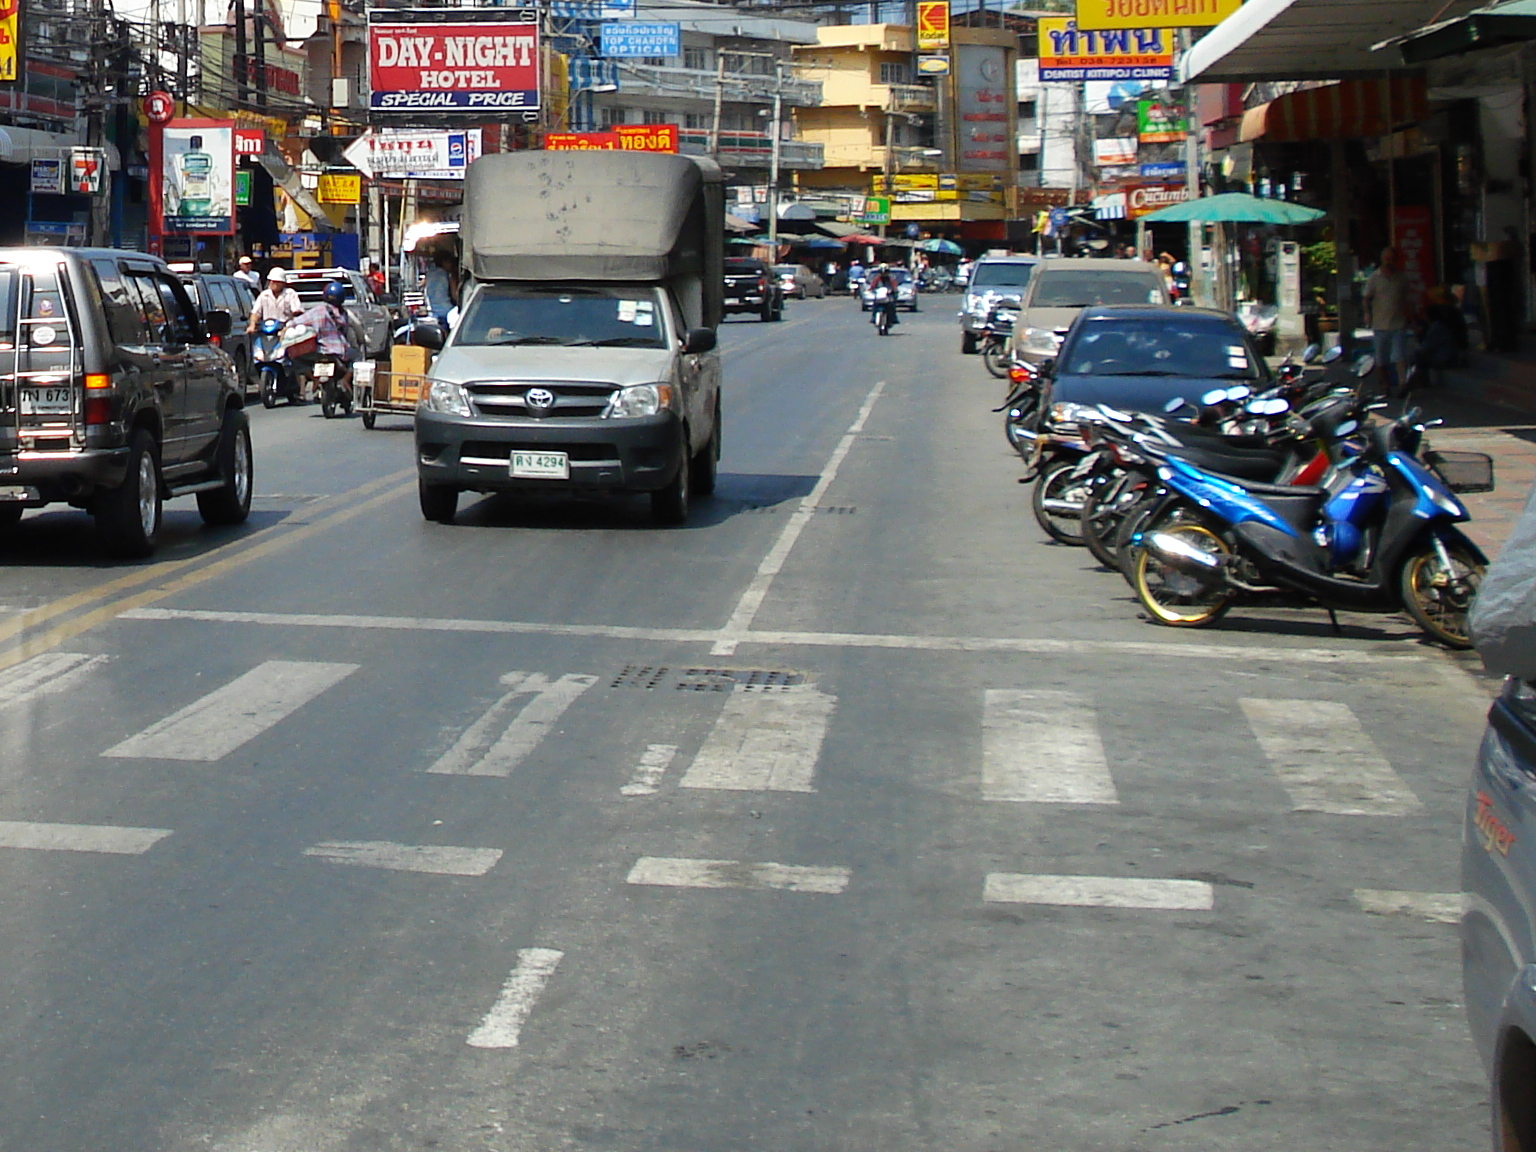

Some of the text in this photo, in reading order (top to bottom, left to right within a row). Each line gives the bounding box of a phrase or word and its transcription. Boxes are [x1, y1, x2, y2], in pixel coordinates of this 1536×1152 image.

[1049, 20, 1164, 55] ทำฟน
[377, 35, 535, 68] DAY-NIGHT
[420, 70, 501, 88] HOTEL
[1043, 68, 1086, 80] DENTIST
[1132, 66, 1170, 78] CLINIC
[380, 92, 525, 107] SPECIAL PRICE
[536, 456, 564, 468] 4294
